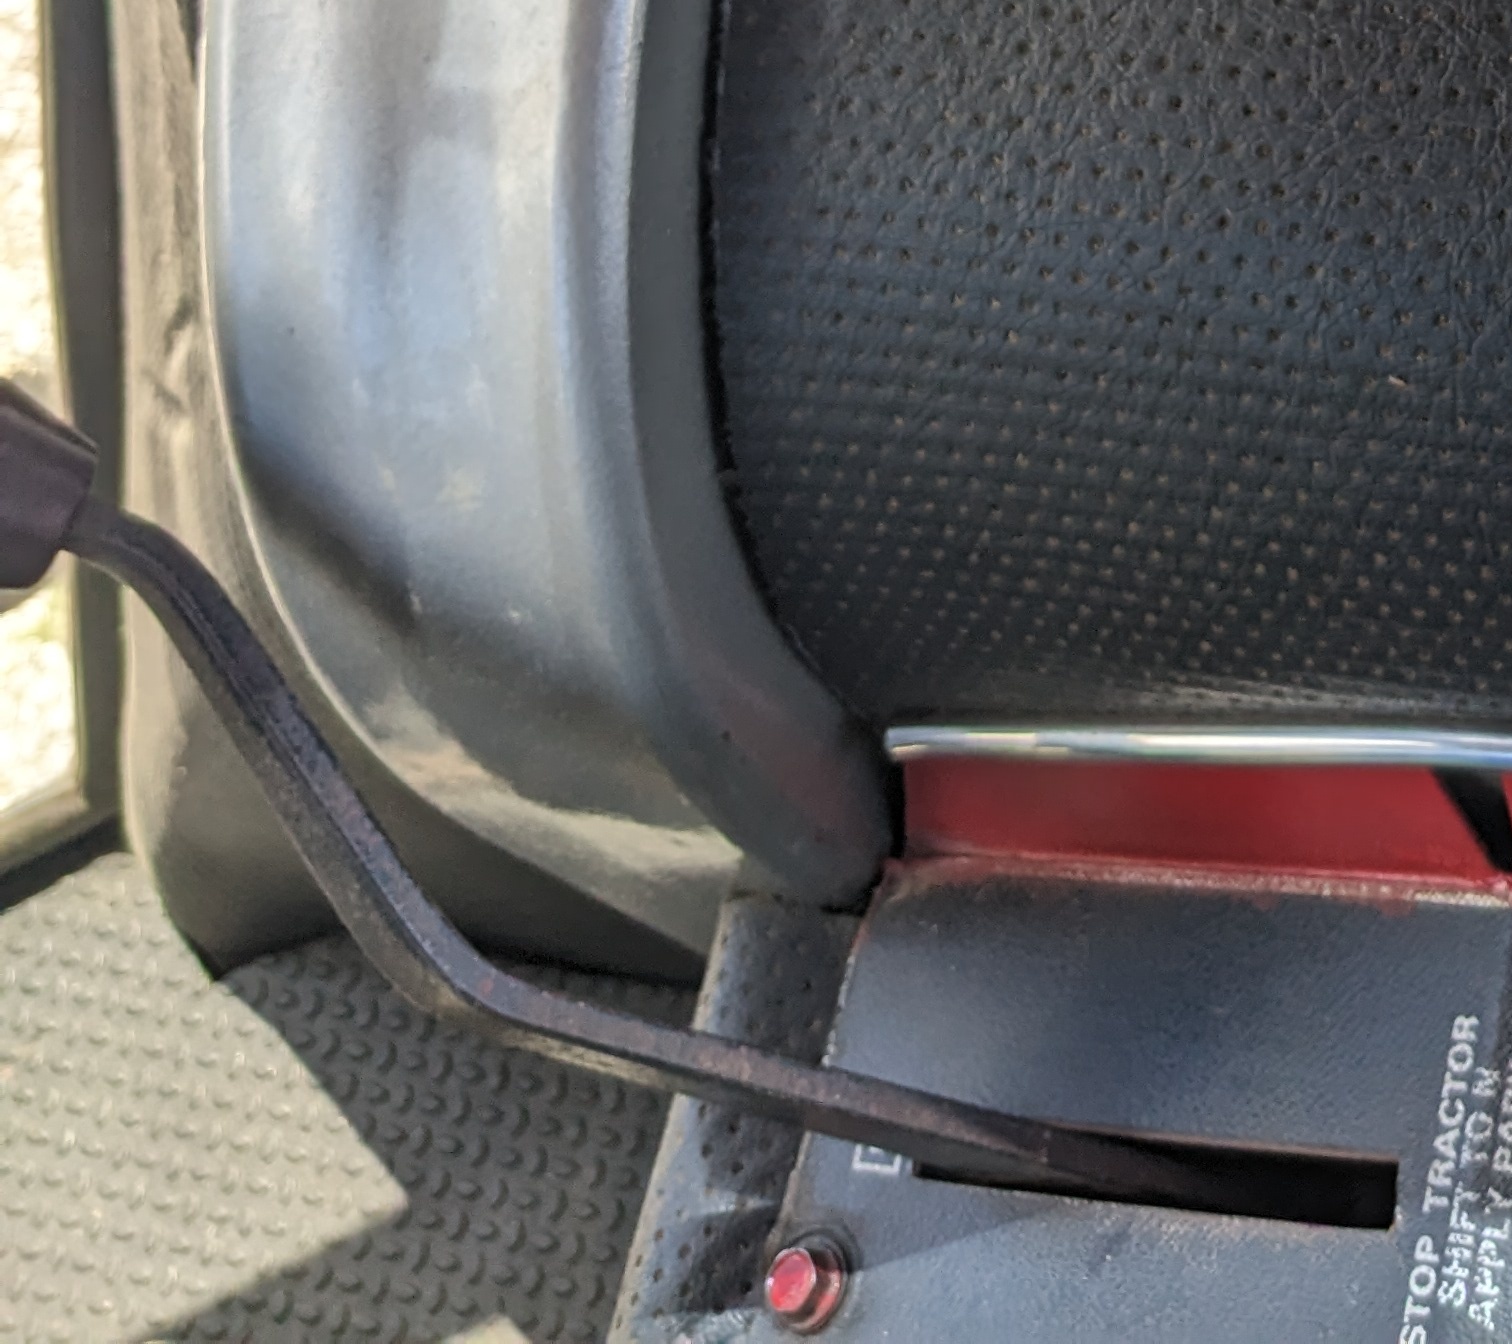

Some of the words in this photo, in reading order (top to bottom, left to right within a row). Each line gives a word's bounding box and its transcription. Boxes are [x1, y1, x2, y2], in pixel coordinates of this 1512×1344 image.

[1400, 1234, 1440, 1344] STOP
[1422, 1014, 1480, 1213] TRACTOR
[1437, 1180, 1481, 1308] SHIFT
[1460, 1111, 1494, 1169] TO
